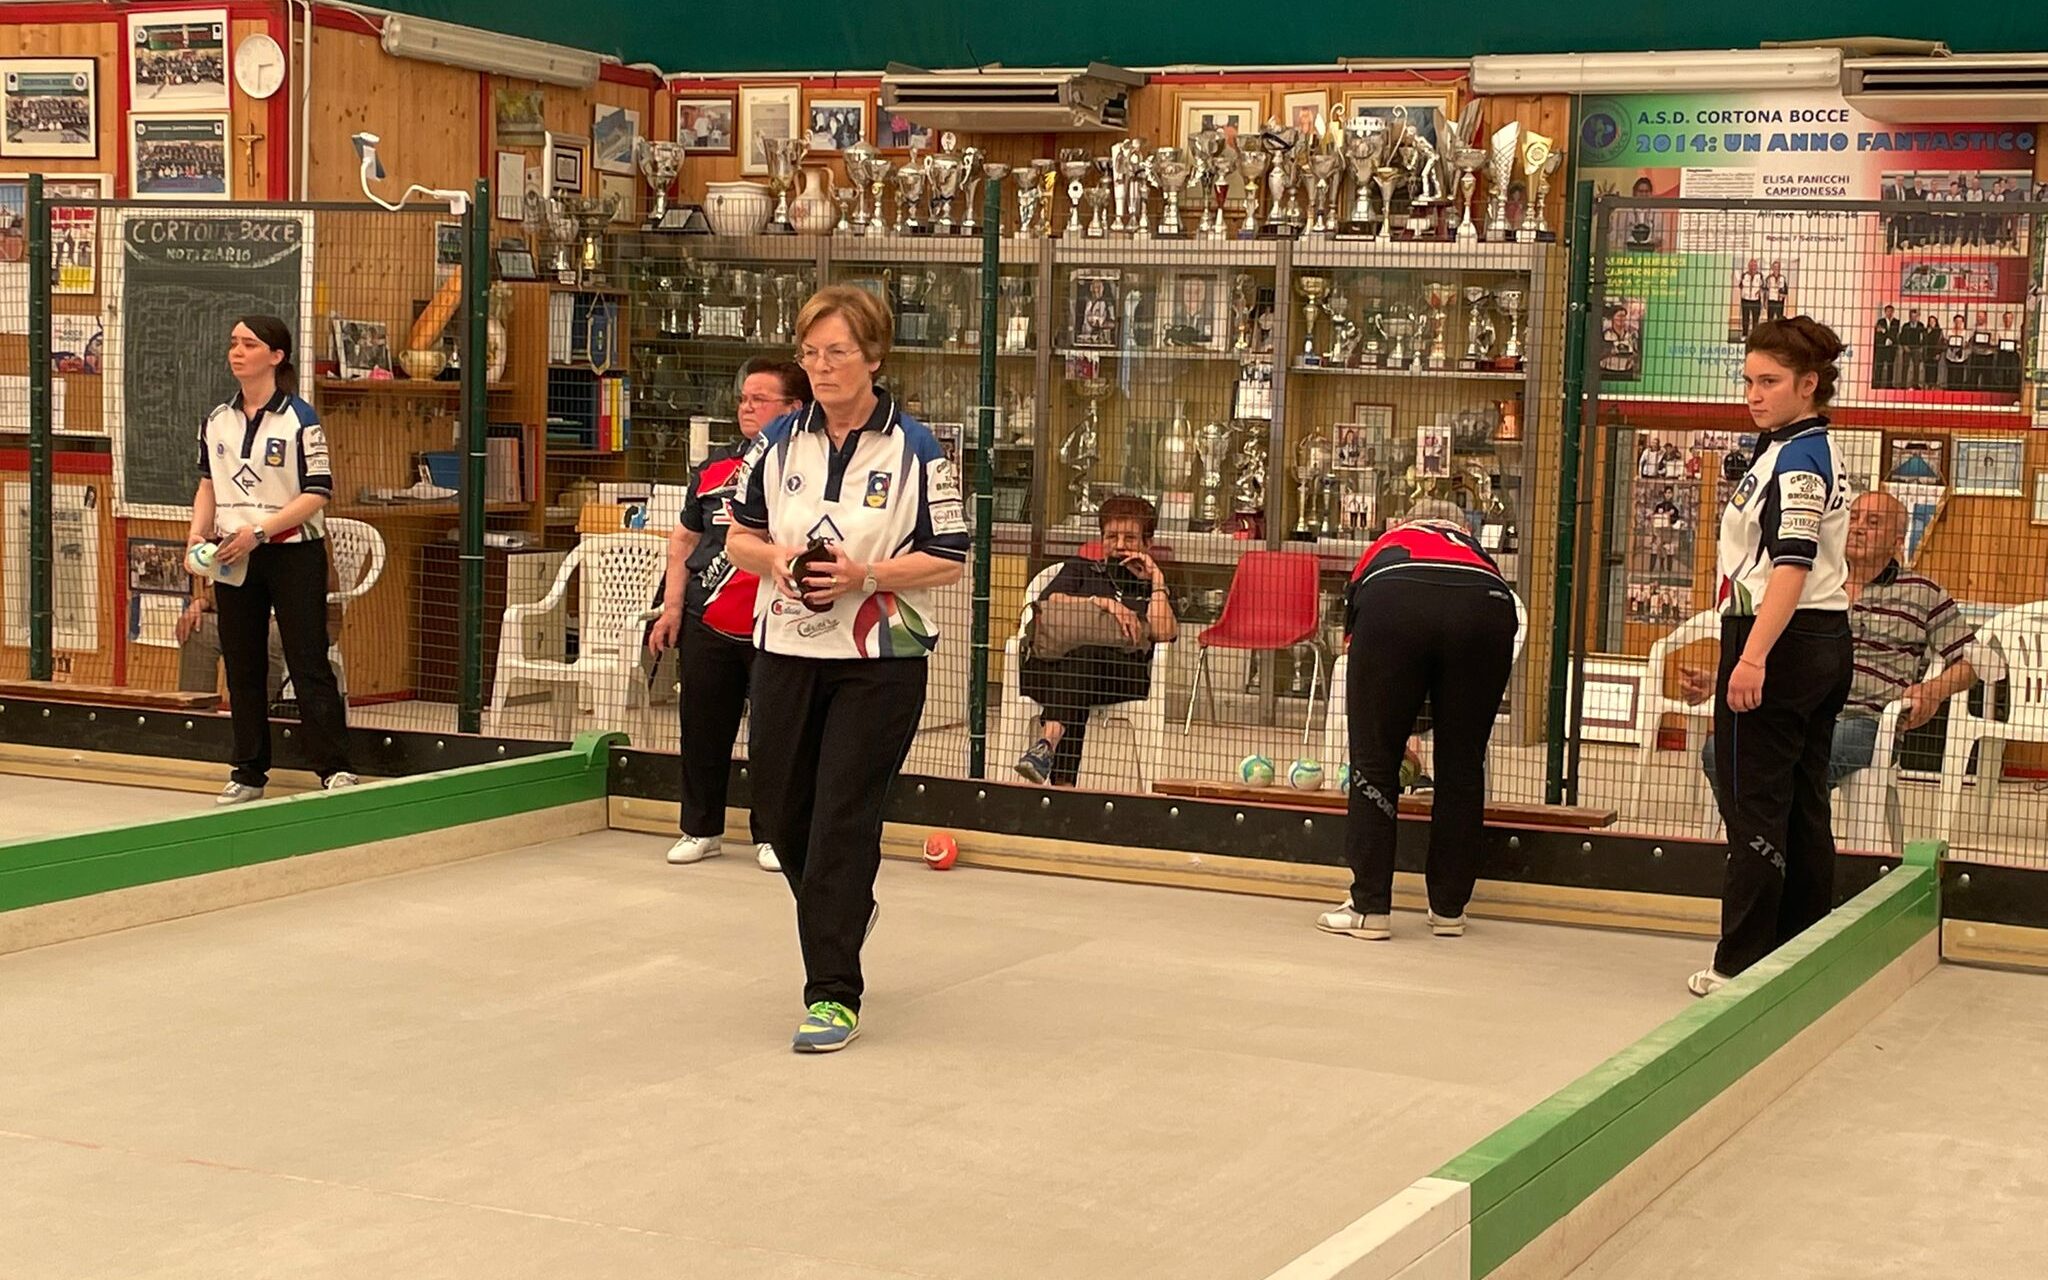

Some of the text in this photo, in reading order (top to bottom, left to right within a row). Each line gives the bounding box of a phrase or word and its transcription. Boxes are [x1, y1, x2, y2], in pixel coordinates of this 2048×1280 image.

[1637, 109, 1849, 125] A.S.D. CORTONA BOCCE
[1636, 131, 2035, 153] 2014: UN ANNO FANTASTICO
[1762, 175, 1850, 184] ELISA FANICCHI
[1765, 186, 1847, 196] CAMPIONESSA
[1749, 834, 1775, 857] 2T
